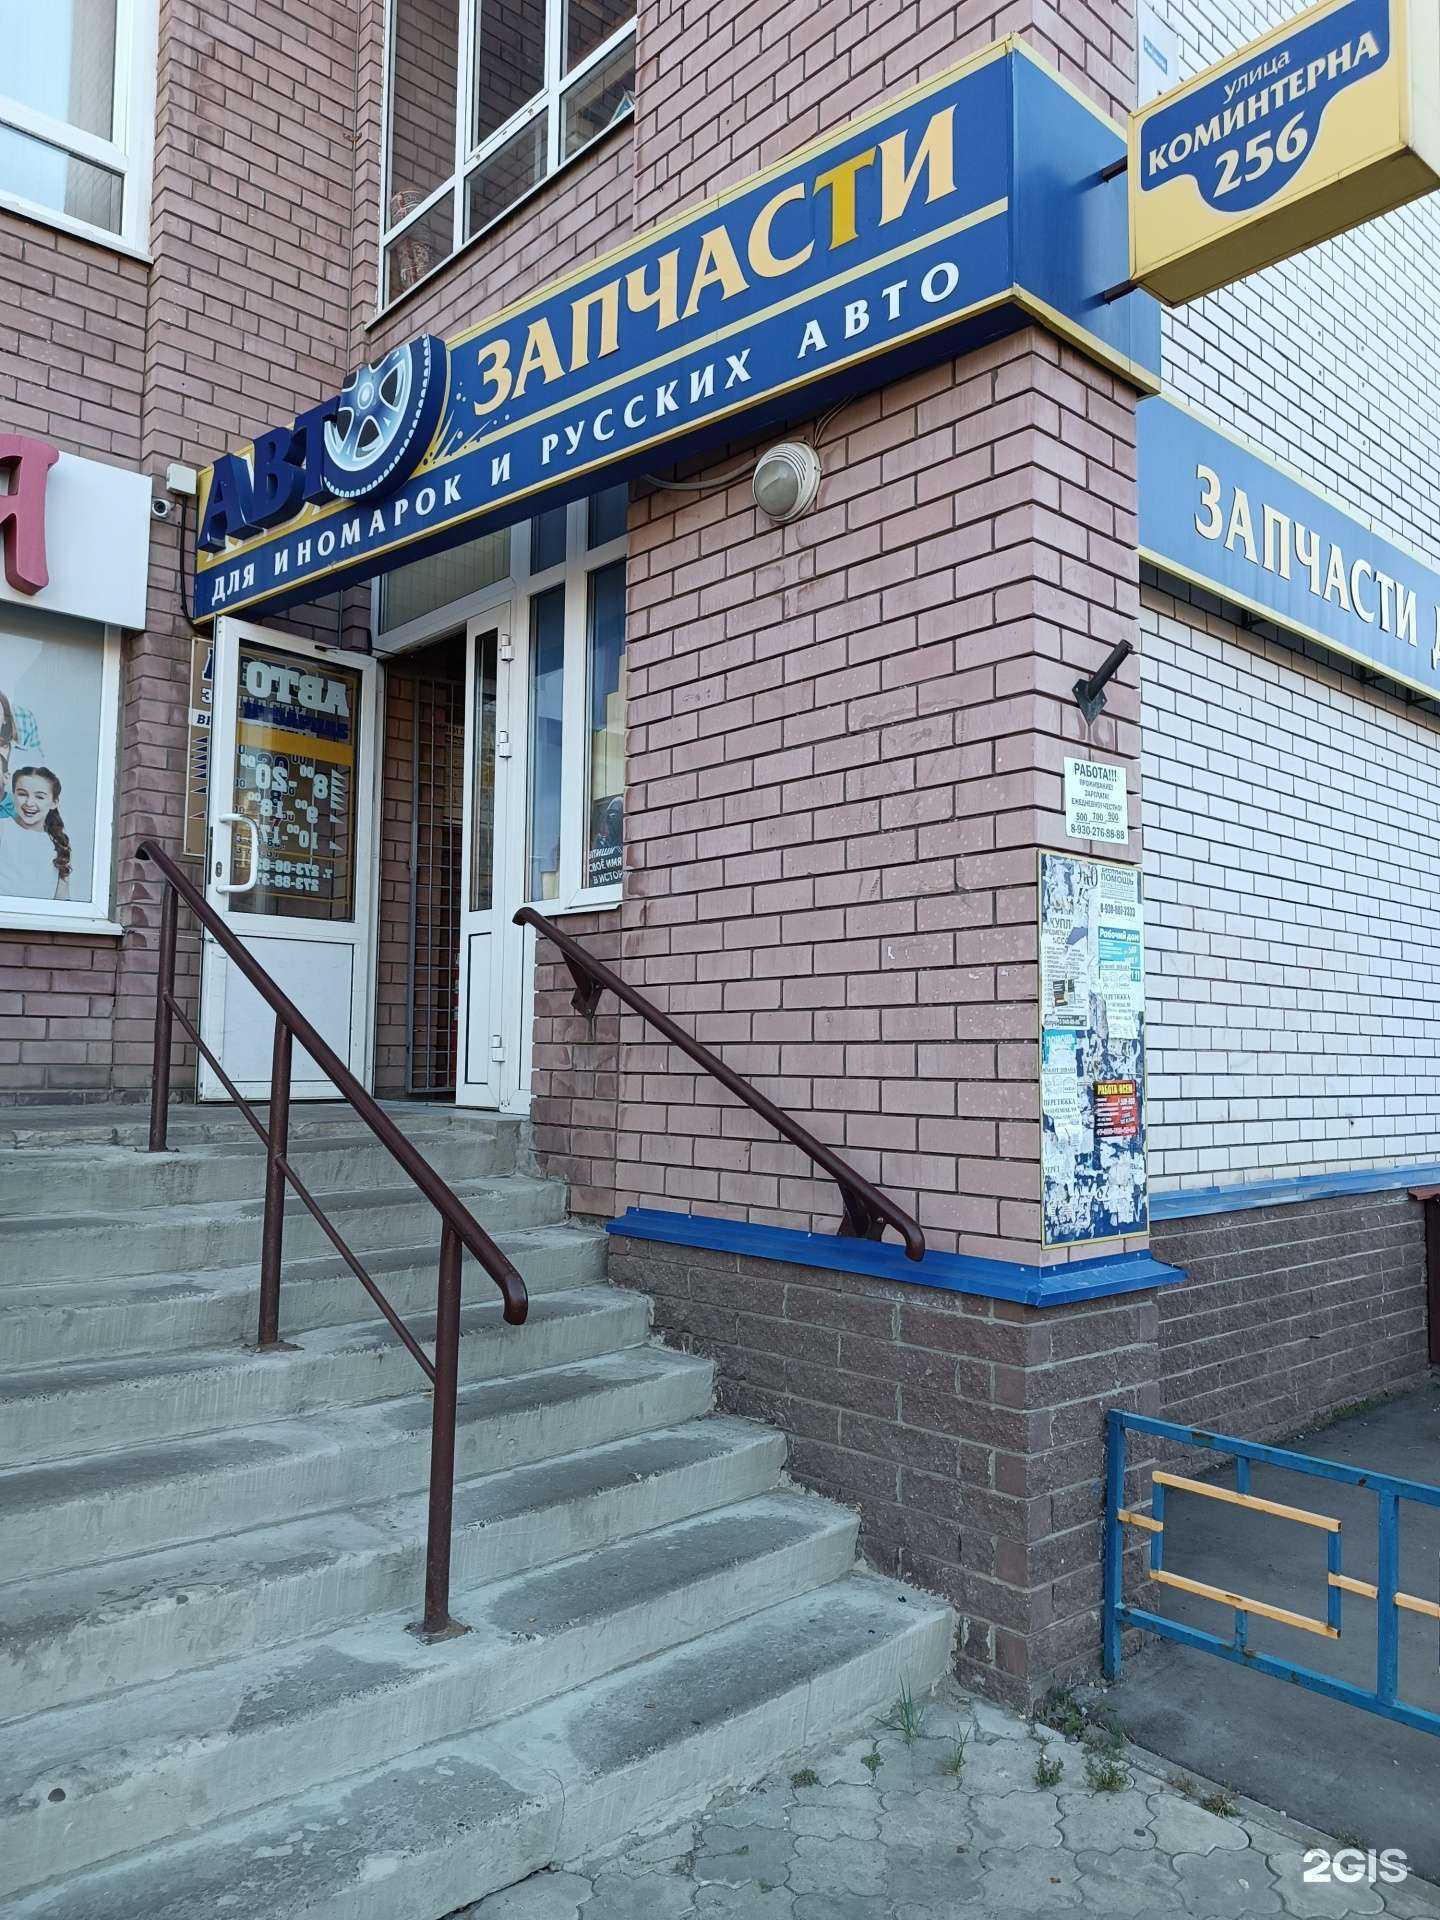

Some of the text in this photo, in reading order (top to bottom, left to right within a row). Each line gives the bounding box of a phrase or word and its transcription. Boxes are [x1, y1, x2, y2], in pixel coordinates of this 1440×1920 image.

[1148, 31, 1380, 176] КОМИНТЕРНА
[1213, 111, 1308, 199] 256
[474, 103, 958, 416] ЗАПЧАСТИ
[211, 261, 960, 606] ДЛЯ ИНОМАРОК И РУССКИХ АВТО
[1193, 463, 1418, 648] ЗАПЧАСТИ
[1074, 763, 1117, 782] РАБОТА!!!
[599, 870, 623, 884] ИСТОР
[1050, 917, 1073, 930] КУПЛ
